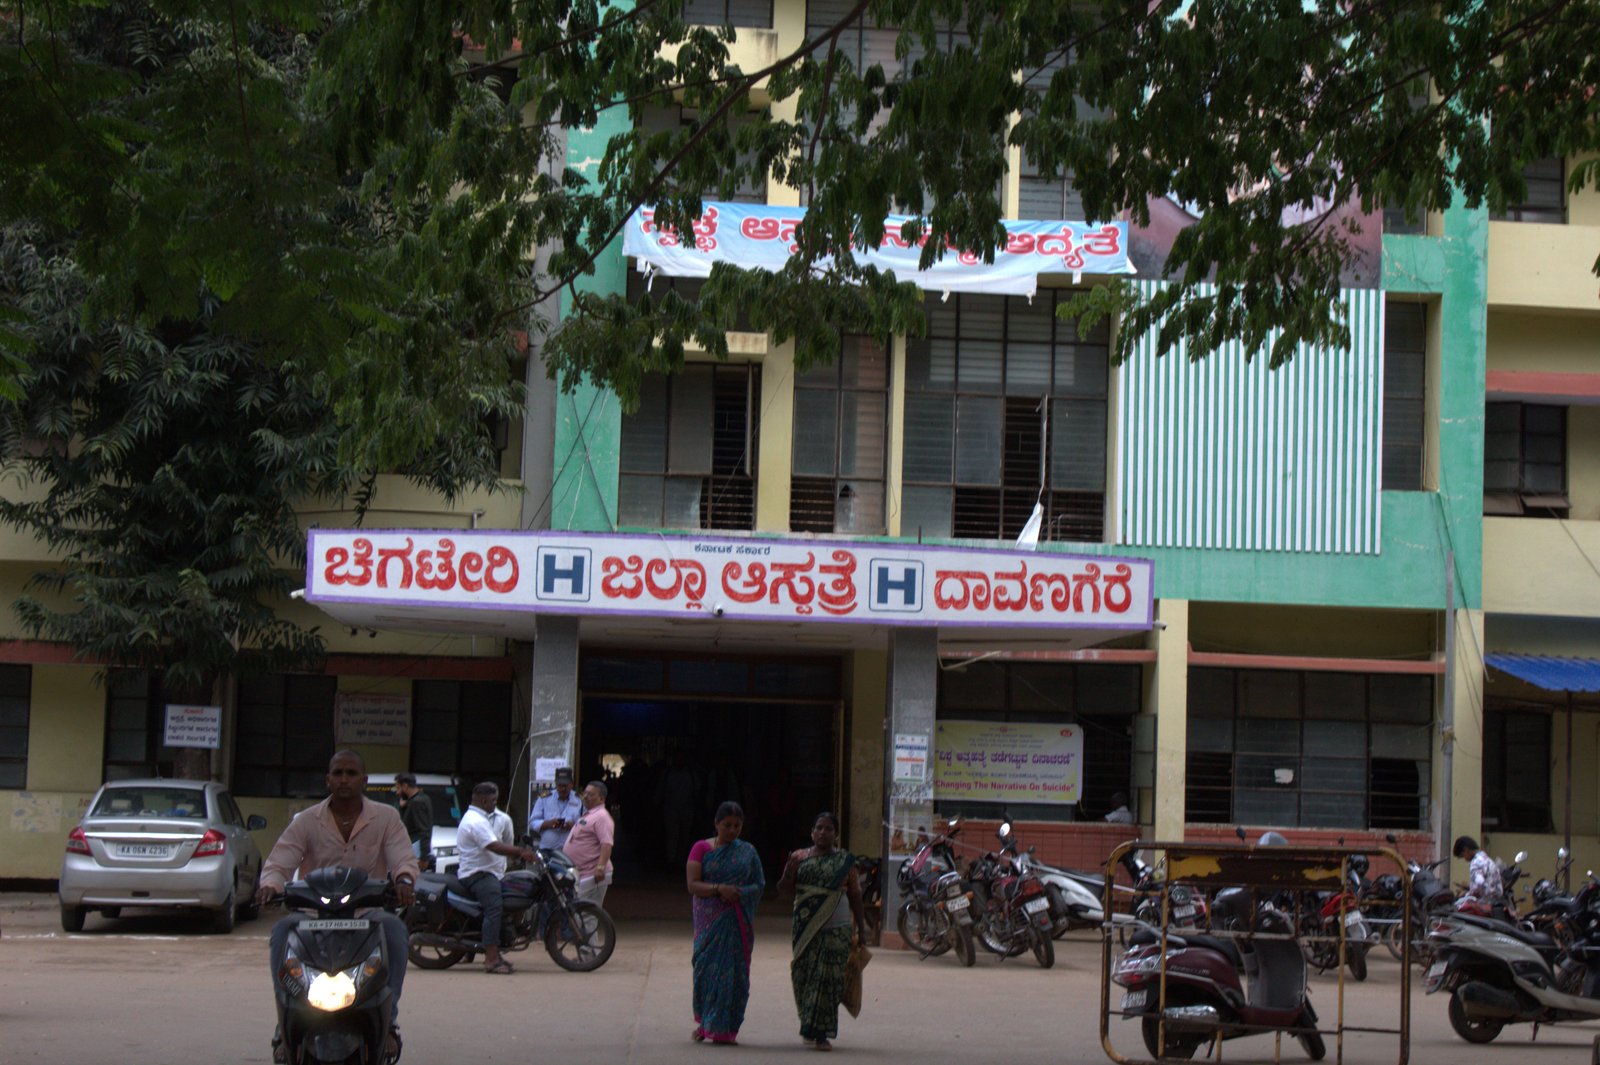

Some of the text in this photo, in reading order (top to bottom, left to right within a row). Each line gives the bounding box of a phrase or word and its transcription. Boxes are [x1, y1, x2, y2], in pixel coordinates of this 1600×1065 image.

[543, 553, 585, 594] H
[602, 556, 706, 609] ಜಿಲ್ಲಾ
[722, 550, 857, 615] ಆಸ್ಪತ್ರೆ
[877, 567, 917, 605] H
[934, 561, 1131, 613] ದಾವಣಗೆರೆ
[974, 780, 989, 790] The
[991, 781, 1027, 791] Narrative
[1029, 782, 1040, 791] On
